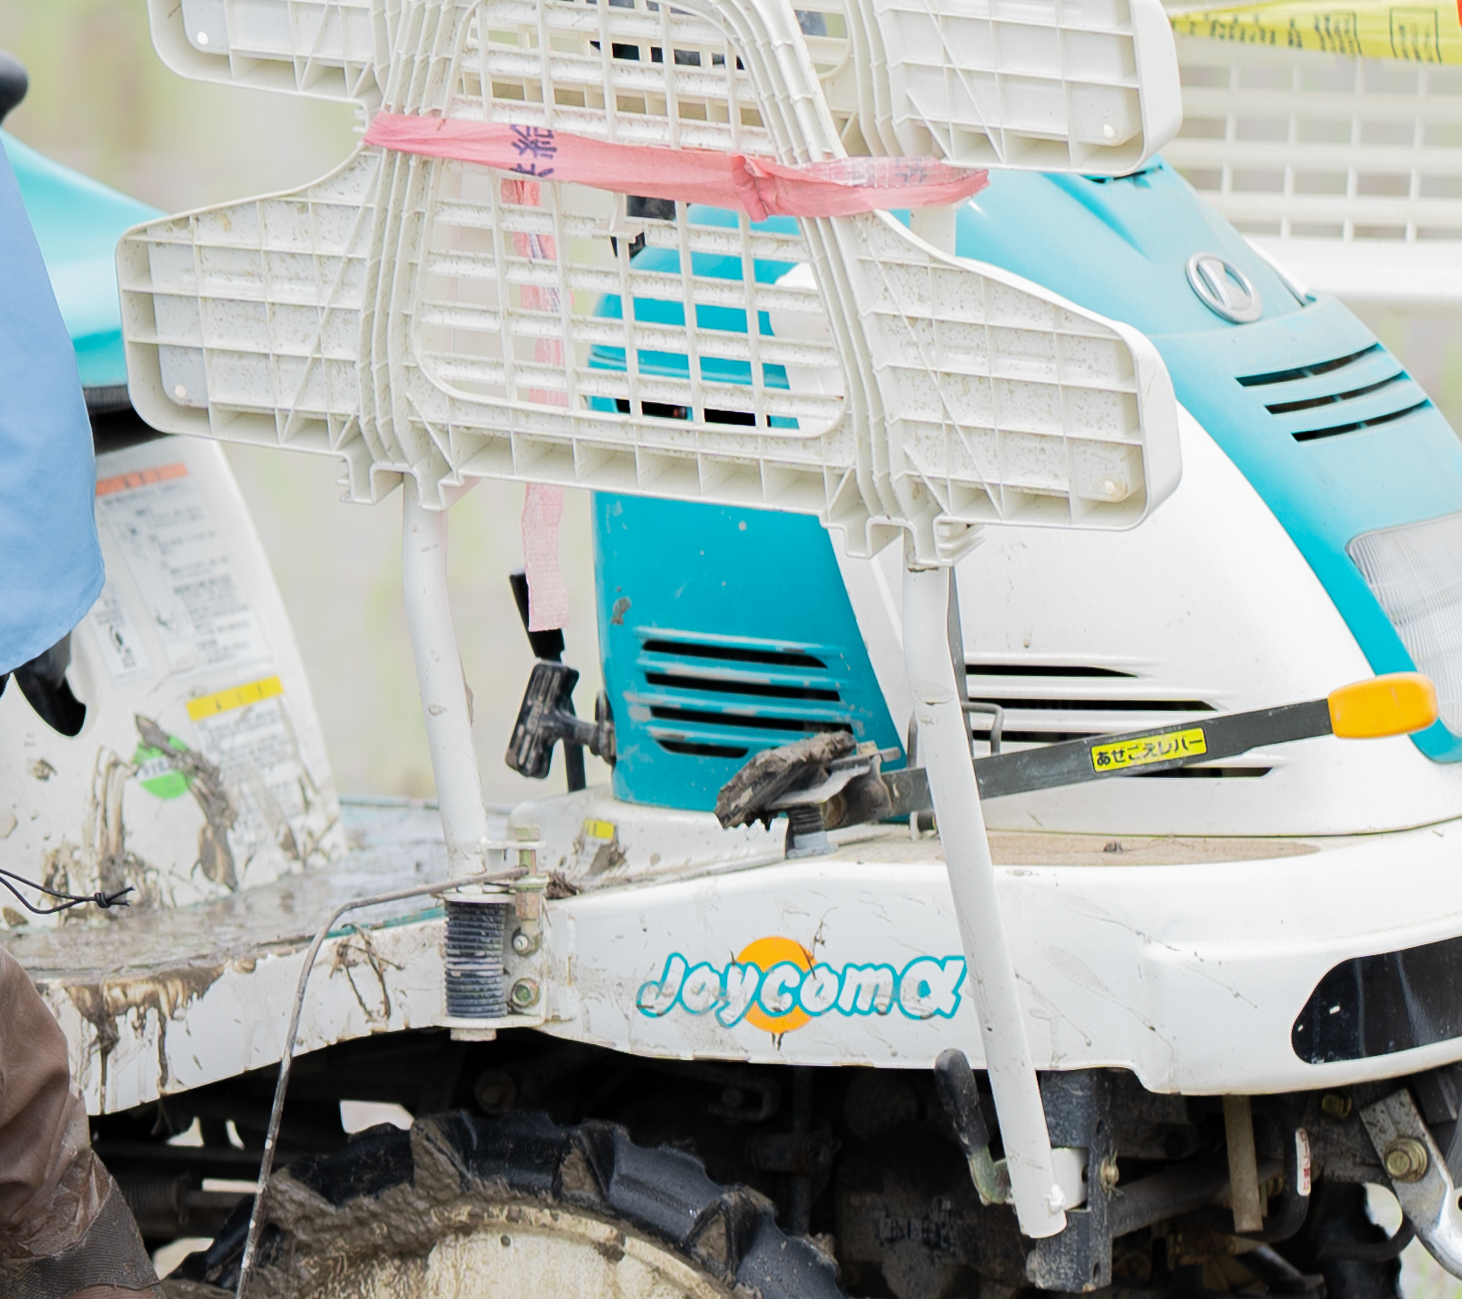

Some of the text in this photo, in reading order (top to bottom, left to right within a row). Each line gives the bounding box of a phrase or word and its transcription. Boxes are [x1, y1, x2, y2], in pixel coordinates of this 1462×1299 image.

[1096, 735, 1204, 766] あぜごえレバー
